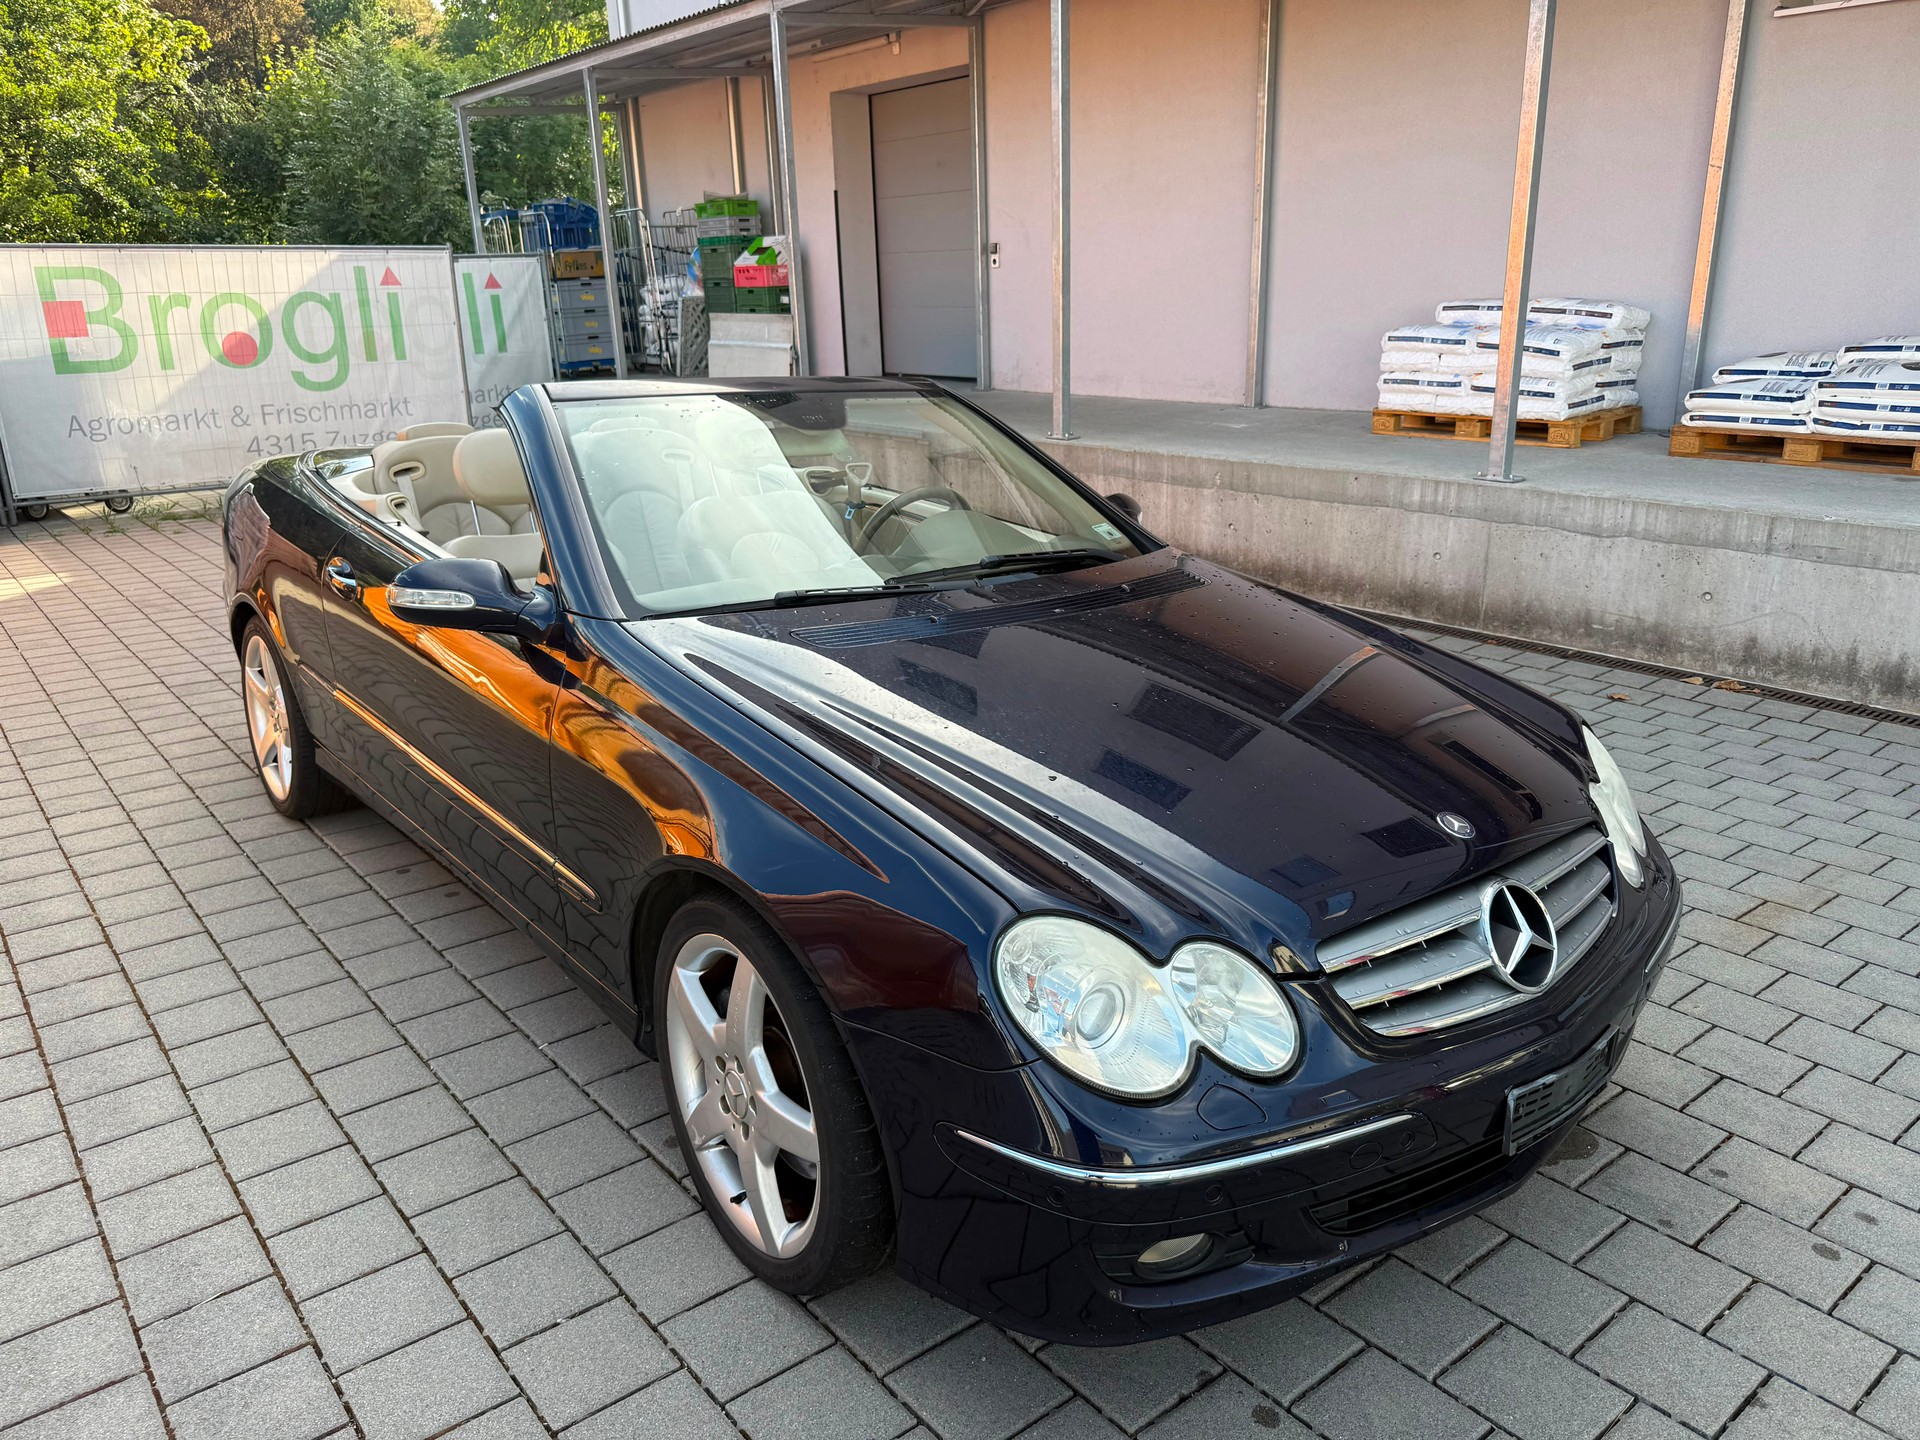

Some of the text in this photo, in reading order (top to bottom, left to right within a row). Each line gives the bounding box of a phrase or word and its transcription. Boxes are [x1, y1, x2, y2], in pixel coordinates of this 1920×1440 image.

[34, 266, 407, 392] Brogli
[68, 397, 414, 442] Agromarkt & Frischmarkt
[247, 430, 398, 458] 4315 Zuzge
